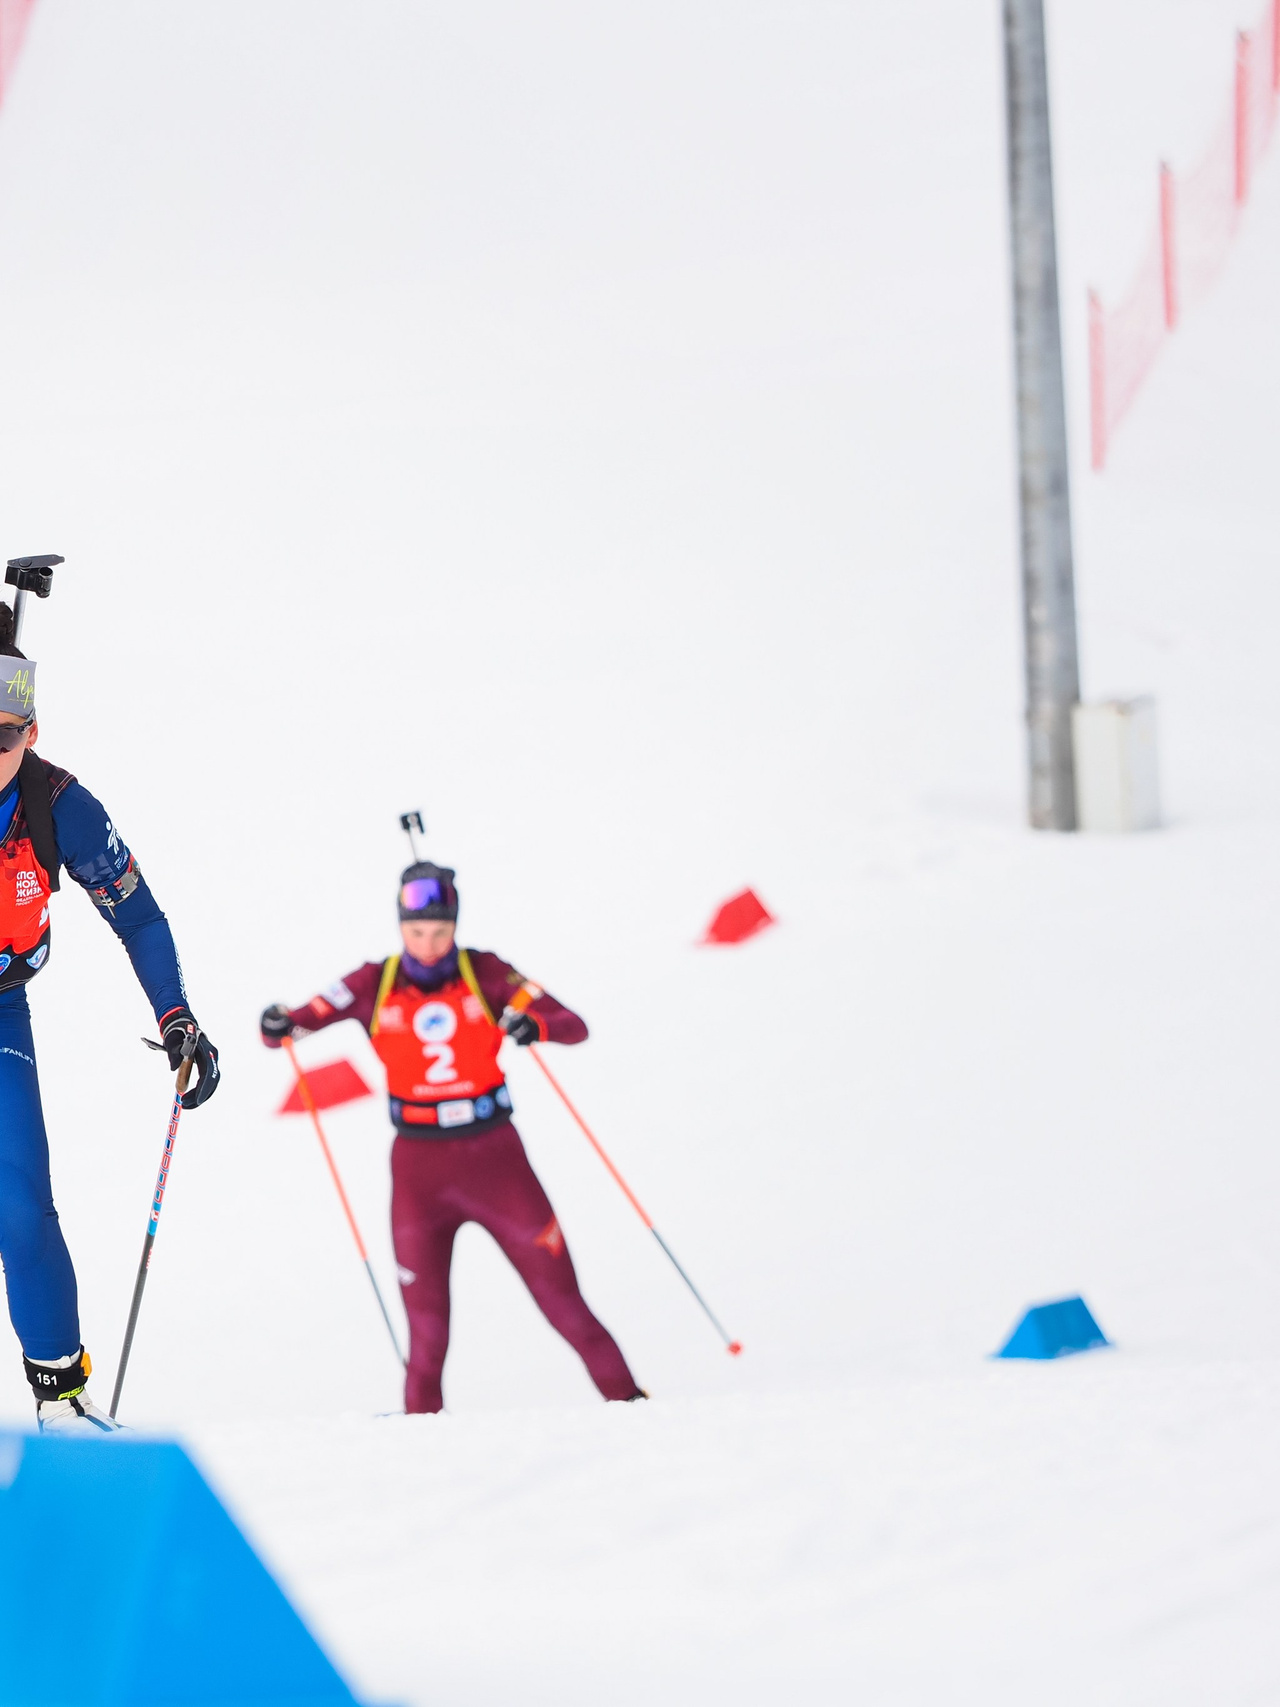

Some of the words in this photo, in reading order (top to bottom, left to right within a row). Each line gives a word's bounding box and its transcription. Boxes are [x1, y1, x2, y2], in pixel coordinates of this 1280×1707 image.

[6, 669, 34, 709] Alp
[422, 1043, 458, 1084] 2
[36, 1372, 57, 1386] 151
